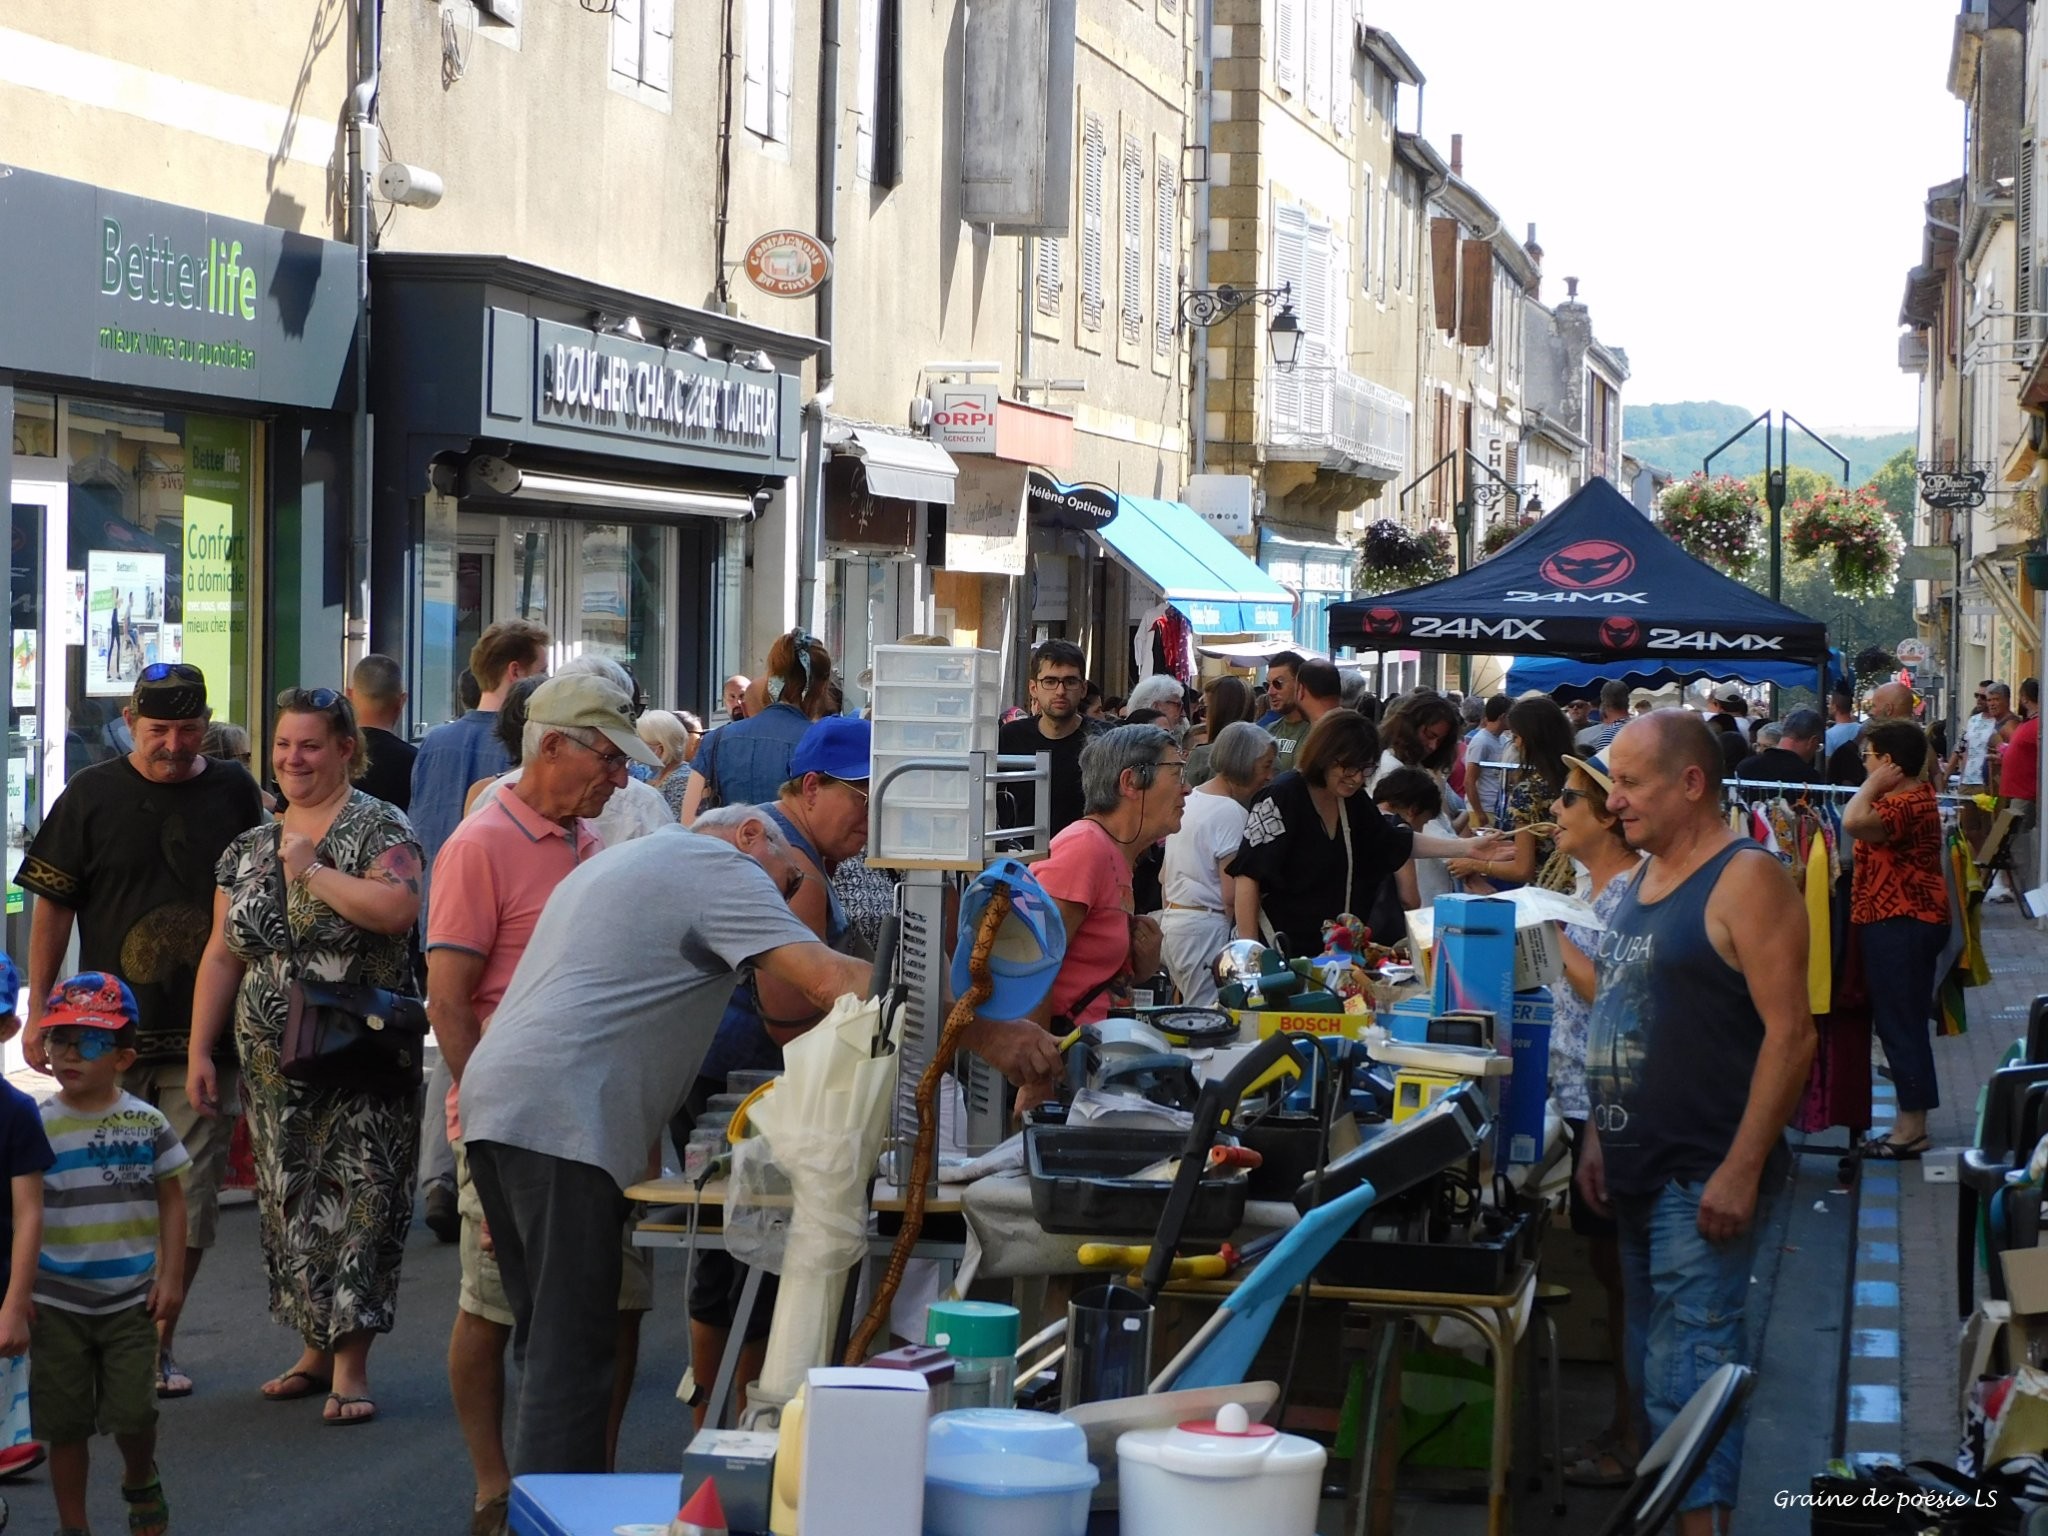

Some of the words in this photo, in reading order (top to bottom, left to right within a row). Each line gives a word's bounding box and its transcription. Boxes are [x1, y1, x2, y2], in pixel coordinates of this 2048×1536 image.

[751, 233, 822, 266] COMPAGNONS
[101, 216, 257, 321] Betterlife
[100, 321, 141, 354] mieux
[145, 327, 175, 359] vivre
[179, 338, 195, 362] au
[199, 338, 256, 371] quotidien
[554, 343, 629, 415] BOUCHER
[934, 411, 994, 426] ORPI
[943, 435, 974, 443] AGENCES
[1028, 484, 1065, 505] Hélène
[1067, 496, 1112, 520] Optique
[187, 523, 245, 562] Confort
[187, 565, 195, 592] à
[198, 565, 245, 592] domicile
[1504, 591, 1649, 604] 24MX
[186, 617, 210, 633] mieux
[211, 616, 227, 633] chez
[1410, 616, 1546, 641] 24MX
[1647, 627, 1784, 651] 24MX
[1599, 930, 1654, 963] CUBA
[1280, 1016, 1341, 1033] BOSCH
